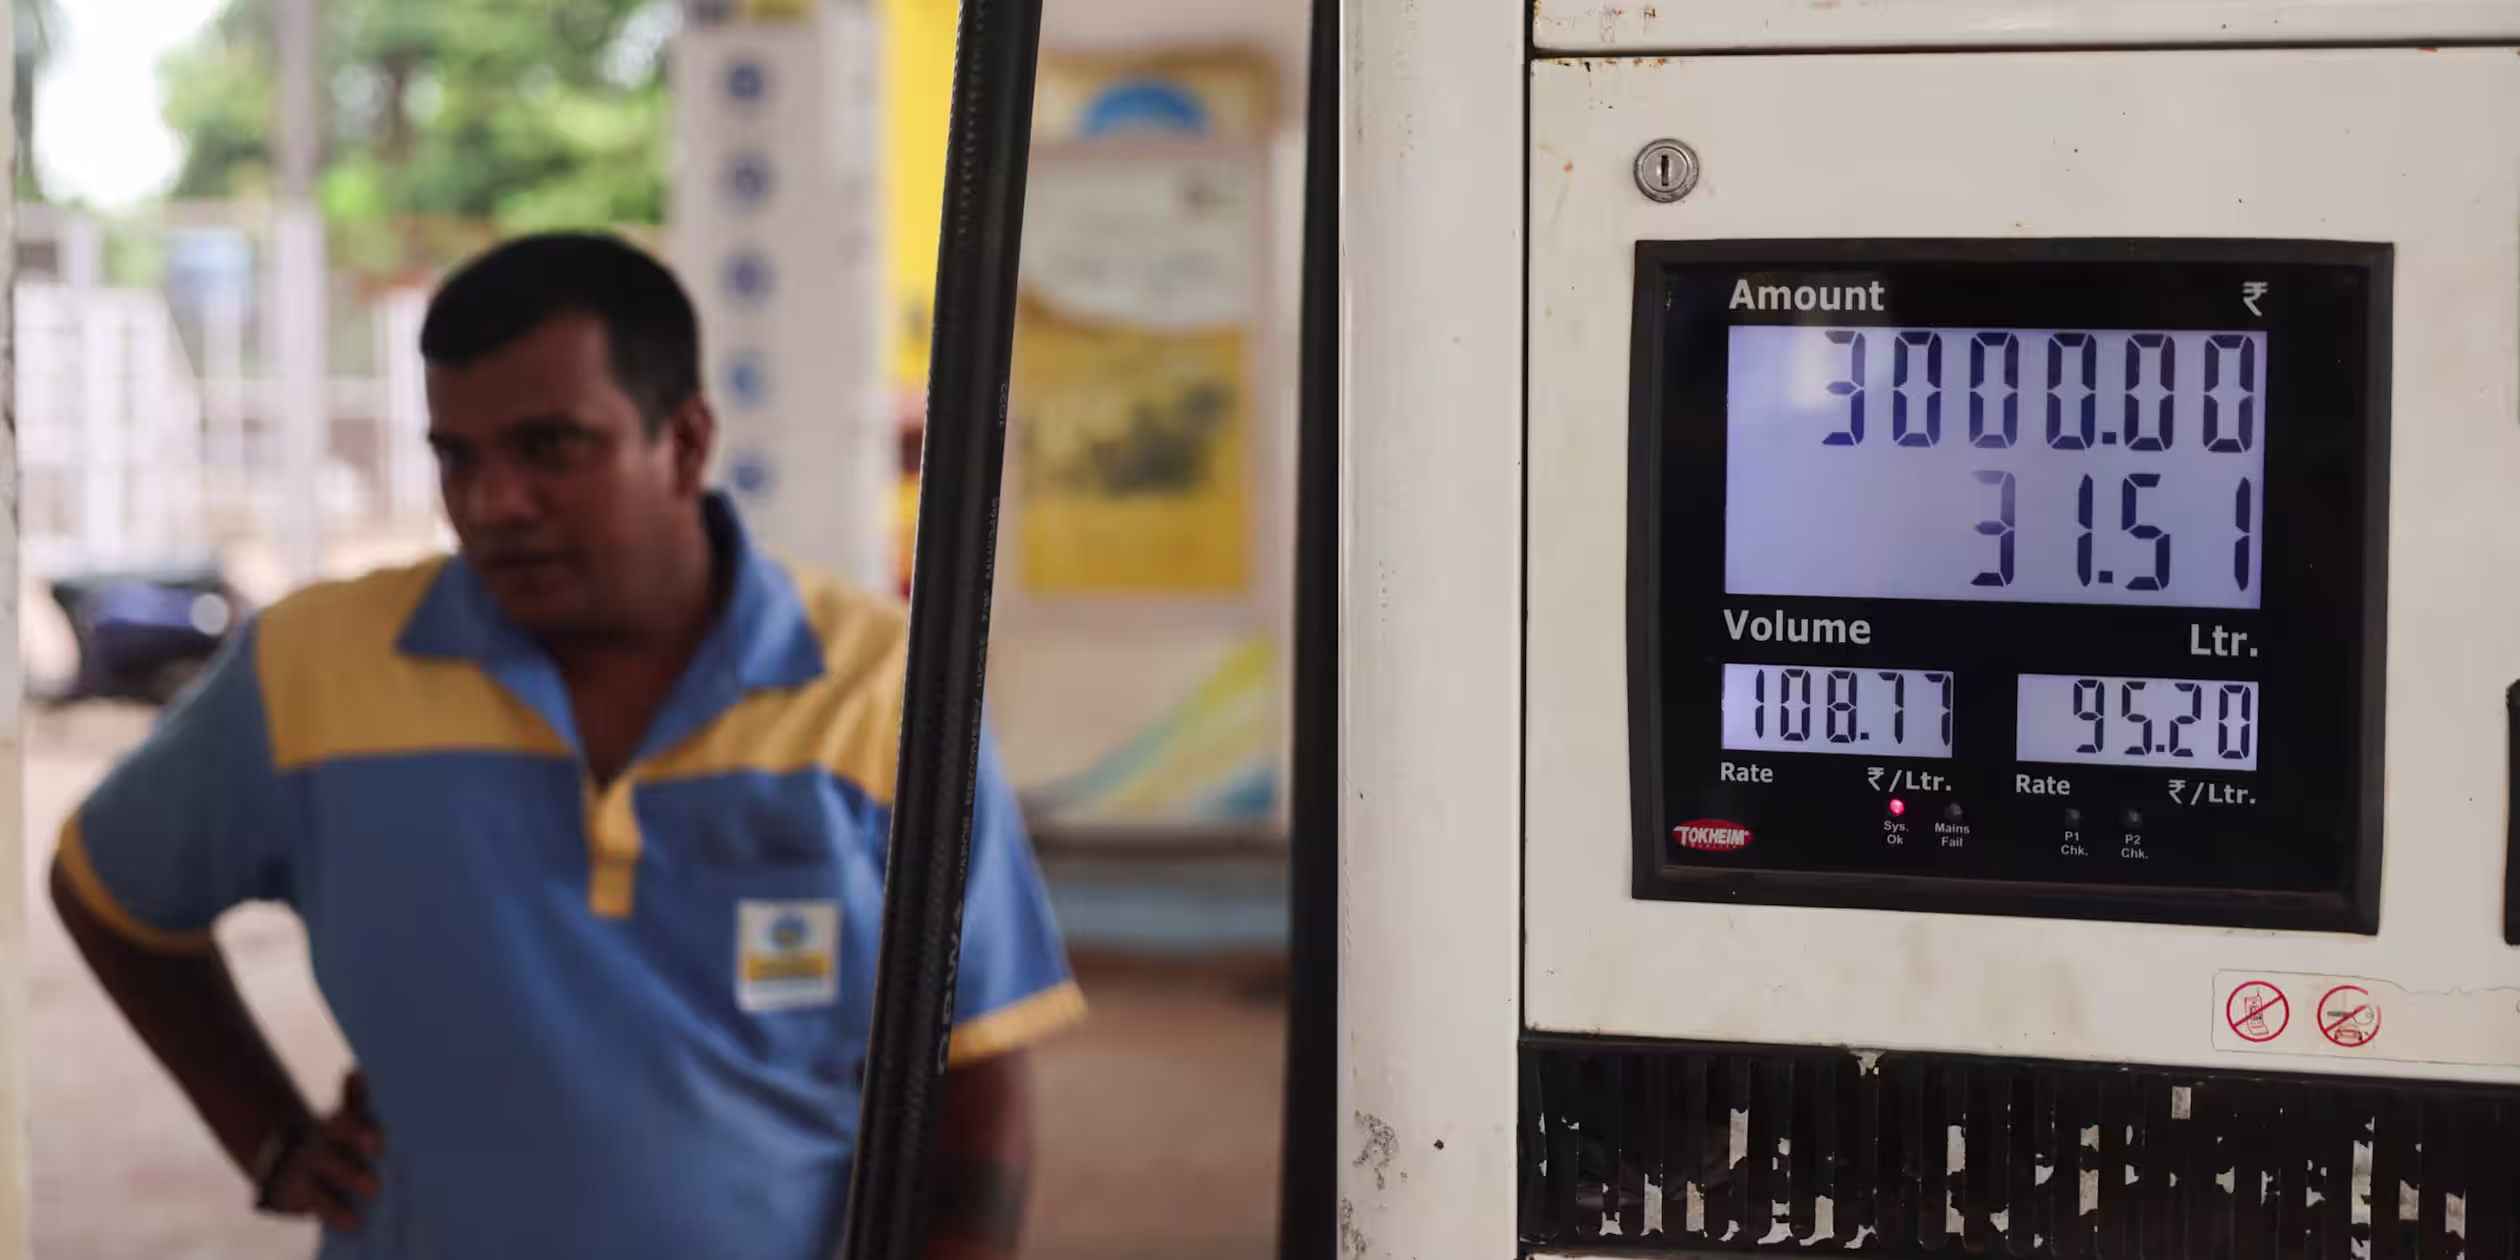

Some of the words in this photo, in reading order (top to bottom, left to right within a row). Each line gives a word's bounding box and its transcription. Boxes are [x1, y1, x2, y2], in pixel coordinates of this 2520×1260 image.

[1730, 280, 1884, 310] Amount
[2243, 282, 2267, 316] ₹
[1822, 332, 2255, 452] 3000.00
[1970, 471, 2251, 592] 31.51
[1724, 609, 1871, 645] Volume
[2190, 623, 2258, 657] Ltr.
[1754, 668, 1951, 745] 108.77
[2073, 678, 2252, 760] 95.20
[1720, 762, 1773, 783] Rate
[2016, 774, 2070, 795] Rate
[1673, 825, 1746, 847] TOKHEIM
[1883, 820, 1909, 833] Sys.
[1934, 822, 1970, 834] Mains
[2064, 831, 2080, 842] P1
[1886, 833, 1903, 845] Ok
[1941, 836, 1963, 847] Fail
[2125, 834, 2141, 845] P2
[2060, 844, 2088, 856] Chk.
[2121, 847, 2149, 859] Chk.
